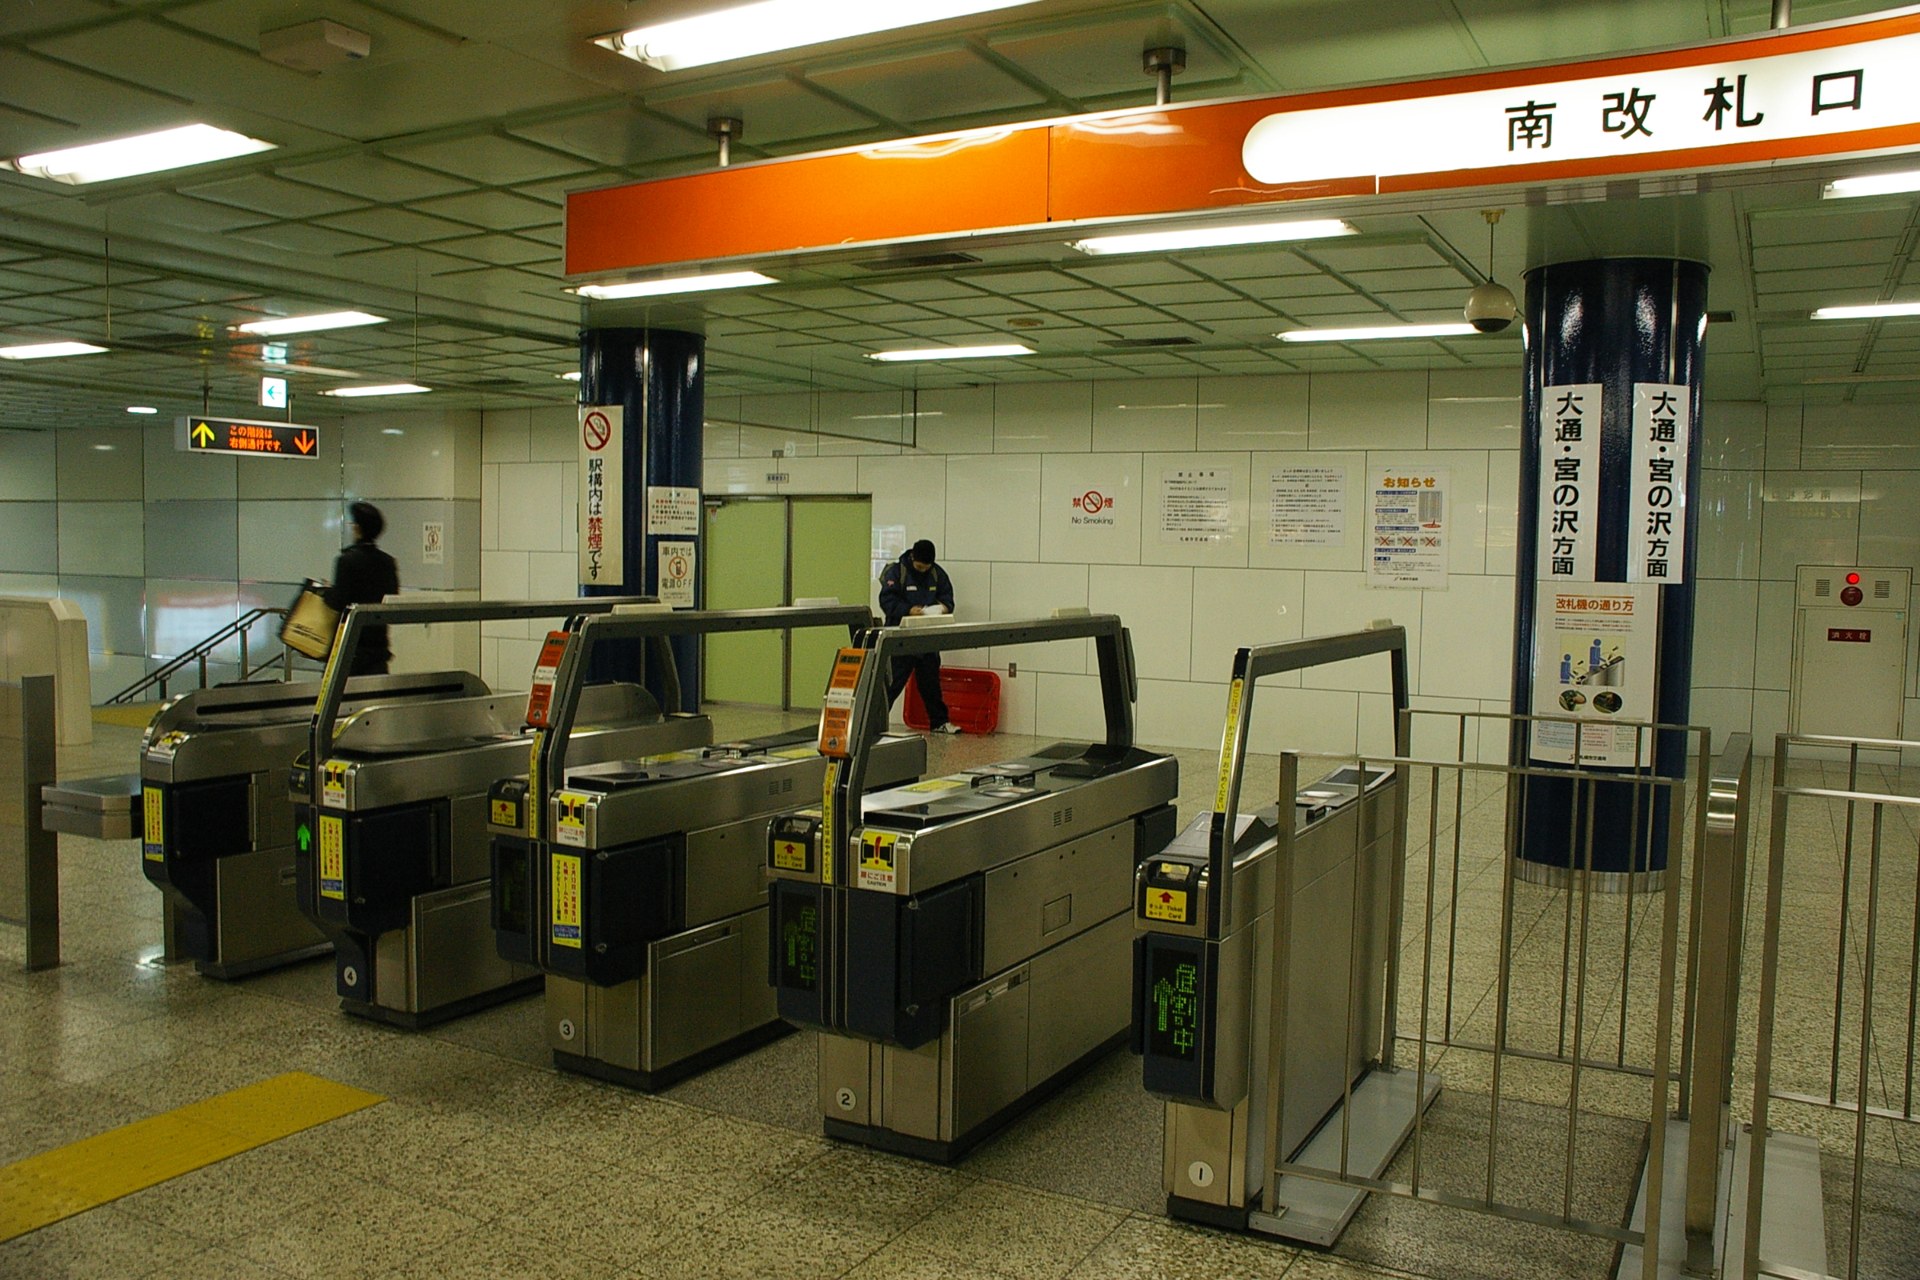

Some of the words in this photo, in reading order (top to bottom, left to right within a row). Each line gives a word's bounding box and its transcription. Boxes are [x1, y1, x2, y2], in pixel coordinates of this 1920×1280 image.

[1504, 68, 1864, 152] 南改札口
[229, 425, 273, 439] この階段は
[1383, 476, 1436, 488] お知らせ
[1551, 391, 1583, 576] 大通・宮の沢方面
[1645, 391, 1678, 578] 大通・宮の沢方面
[587, 457, 603, 580] 駅構内は禁煙です
[1071, 516, 1082, 524] No
[1083, 516, 1113, 525] Smoking
[1555, 597, 1634, 613] 改札機の通り方
[1831, 631, 1867, 640] 消火栓
